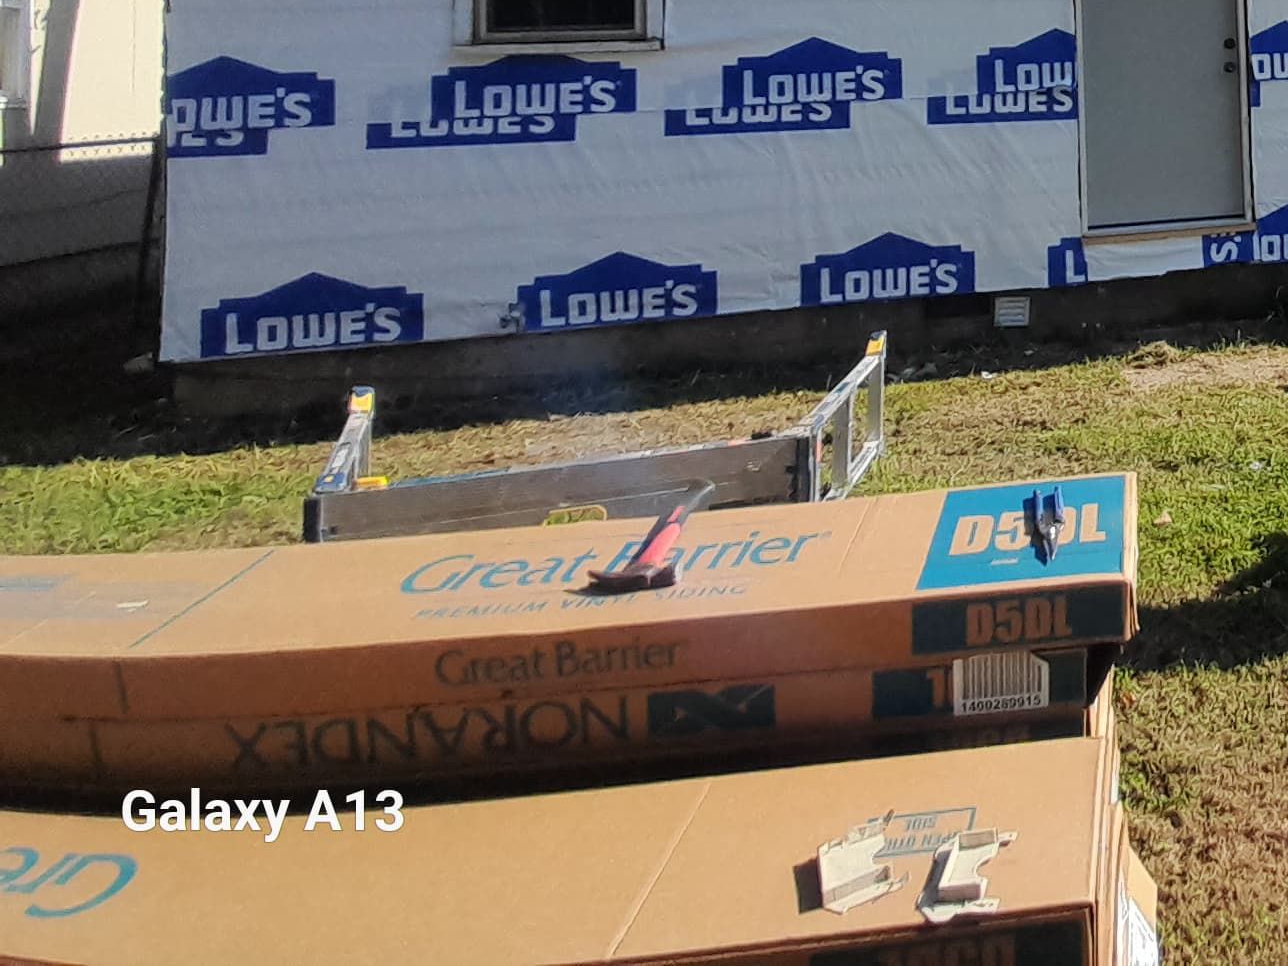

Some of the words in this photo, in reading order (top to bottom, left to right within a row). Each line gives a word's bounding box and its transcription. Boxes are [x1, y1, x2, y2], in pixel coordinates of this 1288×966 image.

[454, 75, 616, 118] LOWE'S
[743, 65, 885, 105] LOWE'S
[539, 280, 699, 327] LOWE'S
[818, 258, 958, 306] LOWE'S
[224, 302, 402, 355] LOWE'S
[400, 547, 598, 595] Great
[434, 646, 543, 687] Great
[553, 636, 682, 677] Barrier
[224, 695, 629, 772] NORANDEX
